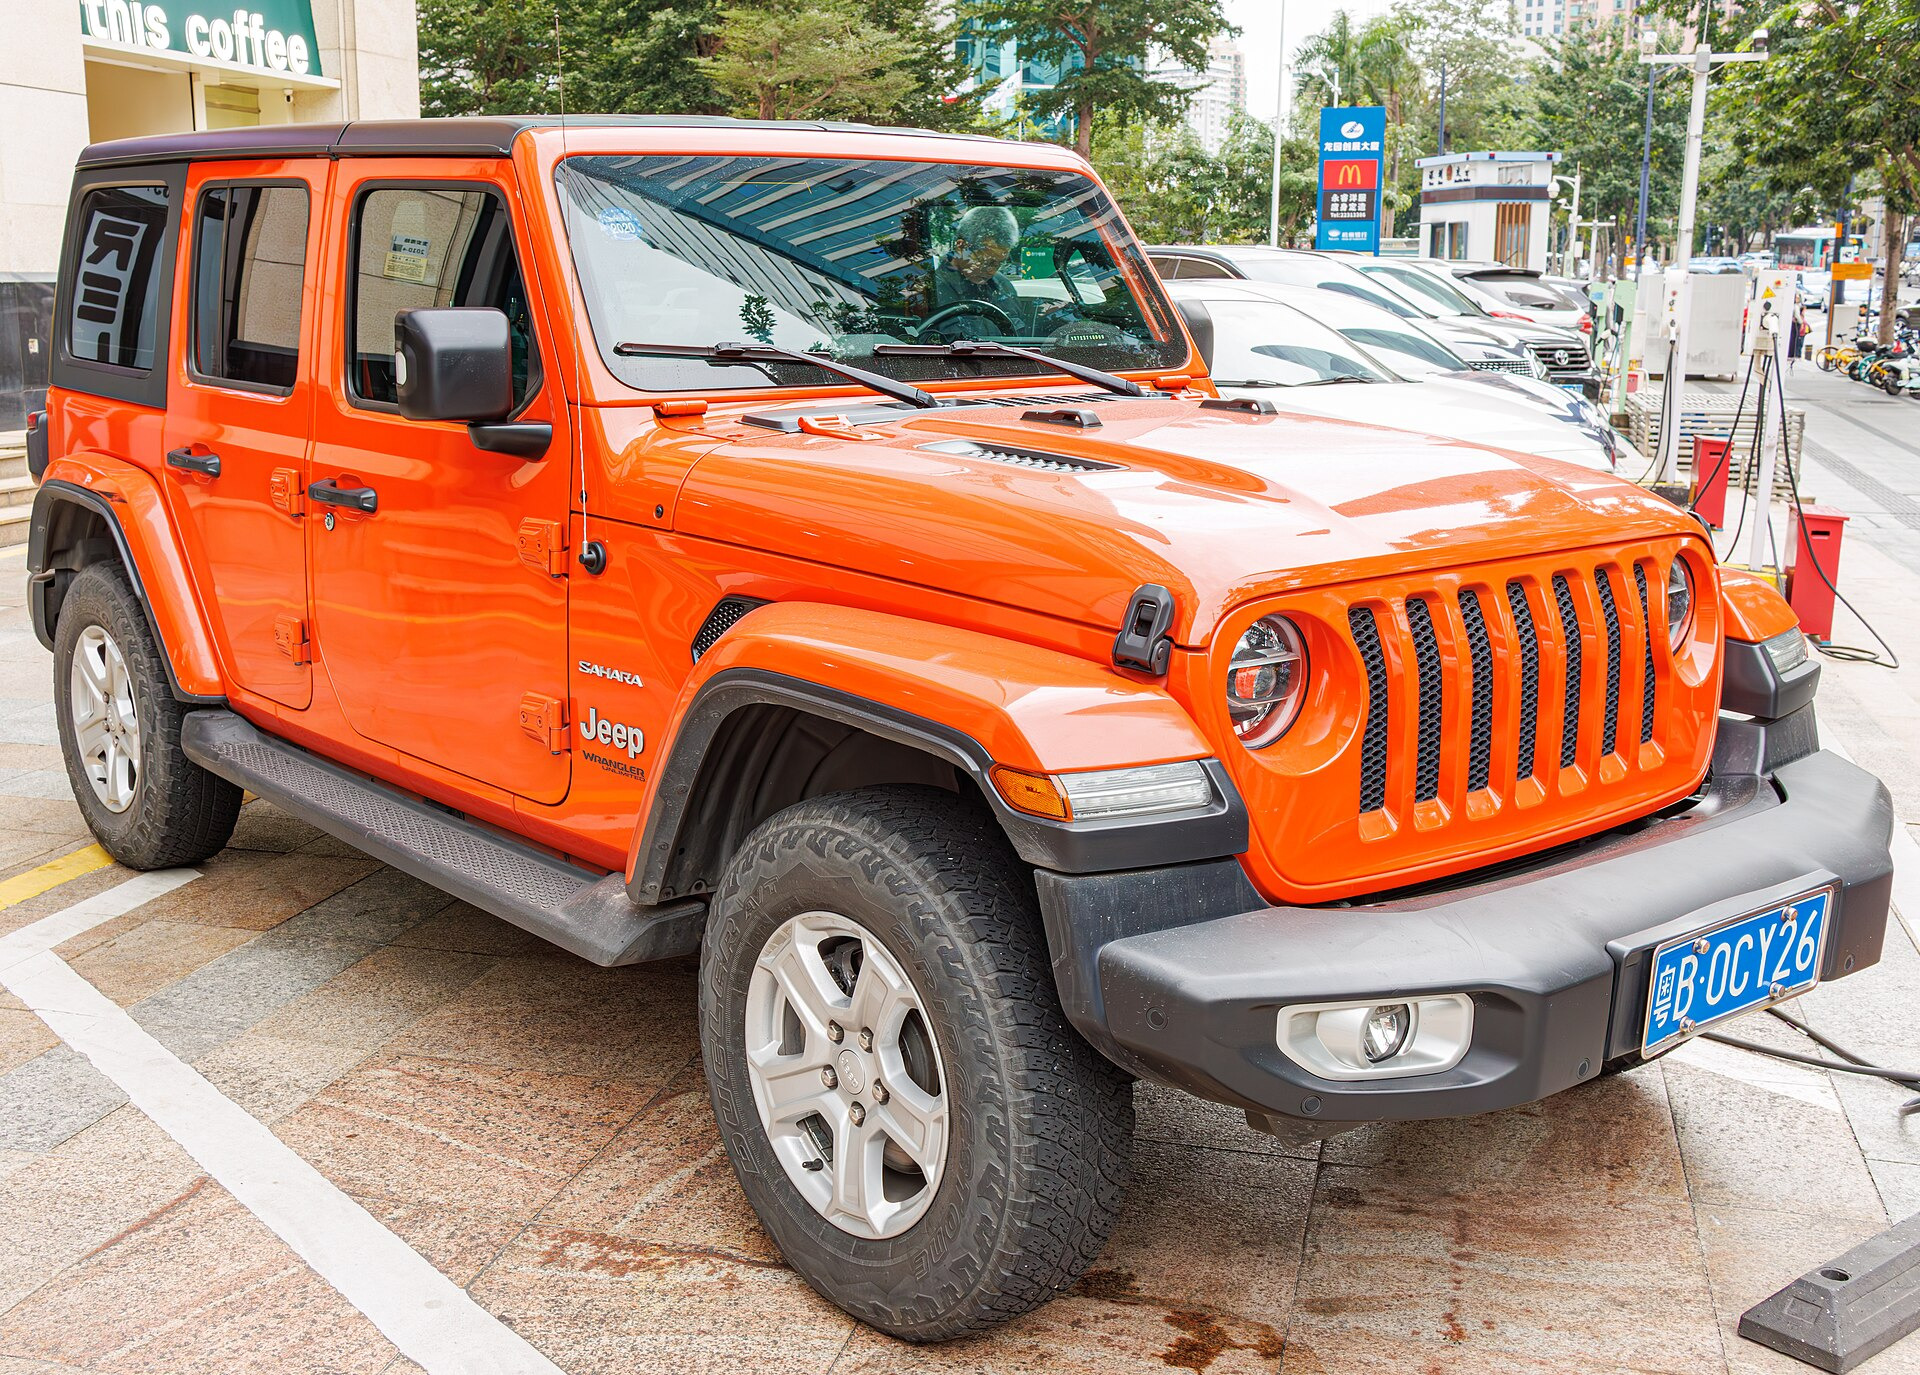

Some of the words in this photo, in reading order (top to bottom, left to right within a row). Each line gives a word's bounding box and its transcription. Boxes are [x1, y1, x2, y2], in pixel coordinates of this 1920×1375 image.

[185, 9, 309, 75] coffee
[610, 222, 636, 233] 2020
[578, 660, 644, 688] SAHARA
[580, 707, 645, 759] Jeep
[582, 750, 645, 777] WRANGLER
[601, 765, 646, 782] UNLIMITED
